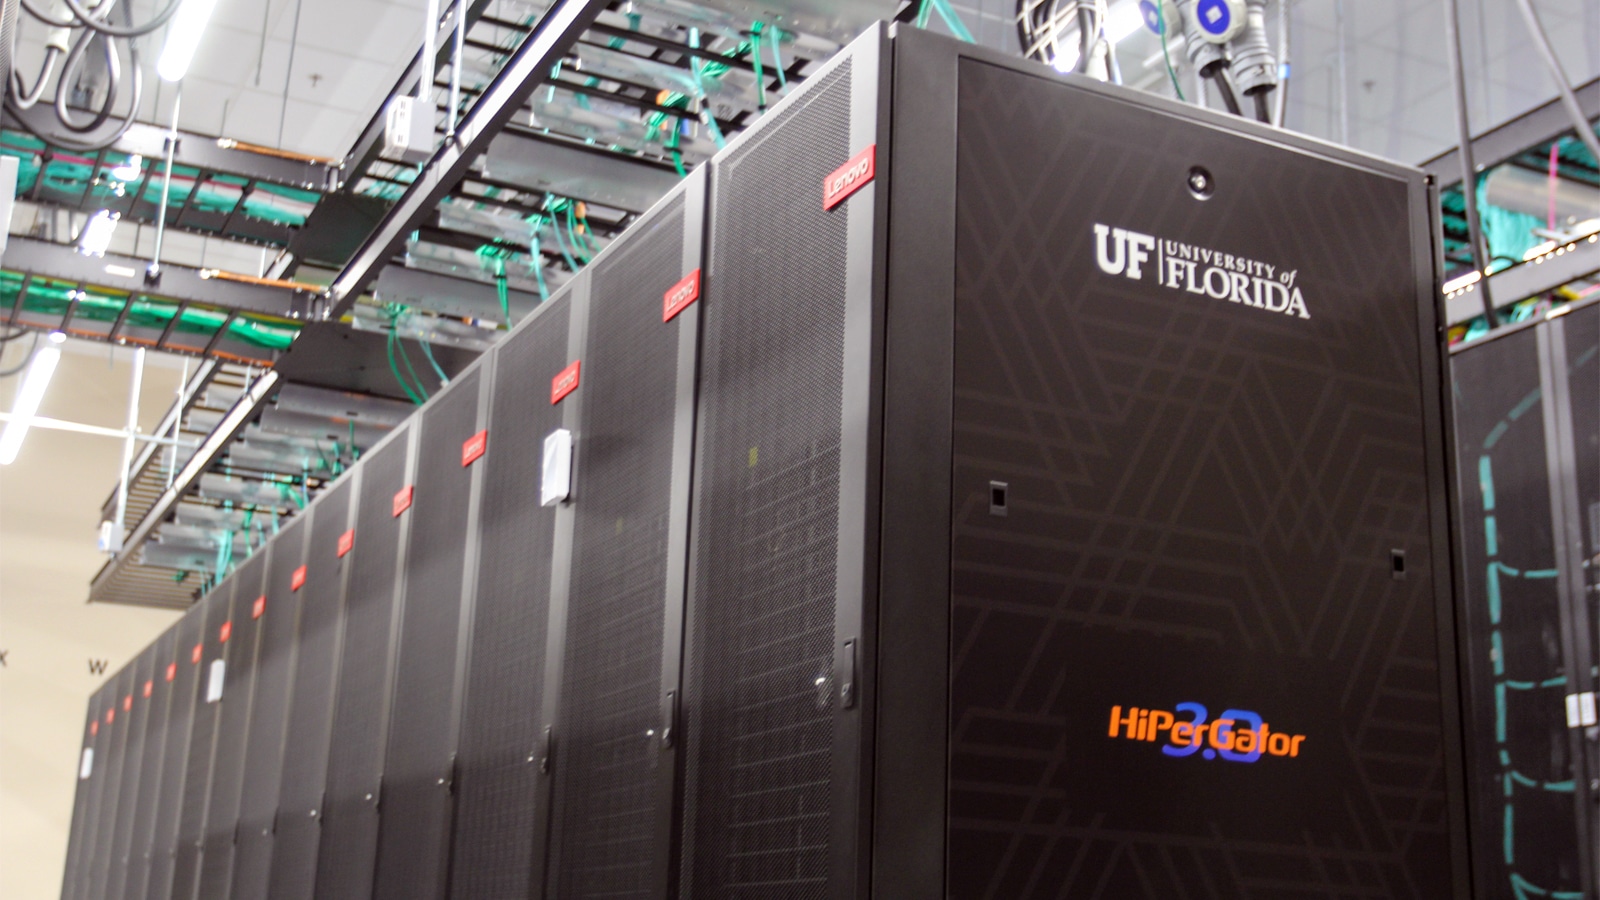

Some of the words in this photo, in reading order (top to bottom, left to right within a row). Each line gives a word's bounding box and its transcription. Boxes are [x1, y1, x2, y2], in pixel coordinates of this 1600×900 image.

[828, 157, 870, 199] Lenovo
[1093, 222, 1156, 280] UF
[1165, 239, 1276, 279] UNIVERSITY
[1279, 269, 1298, 289] of
[1165, 256, 1311, 320] FLORIDA
[87, 657, 109, 675] W
[1108, 705, 1307, 758] HiPerGator
